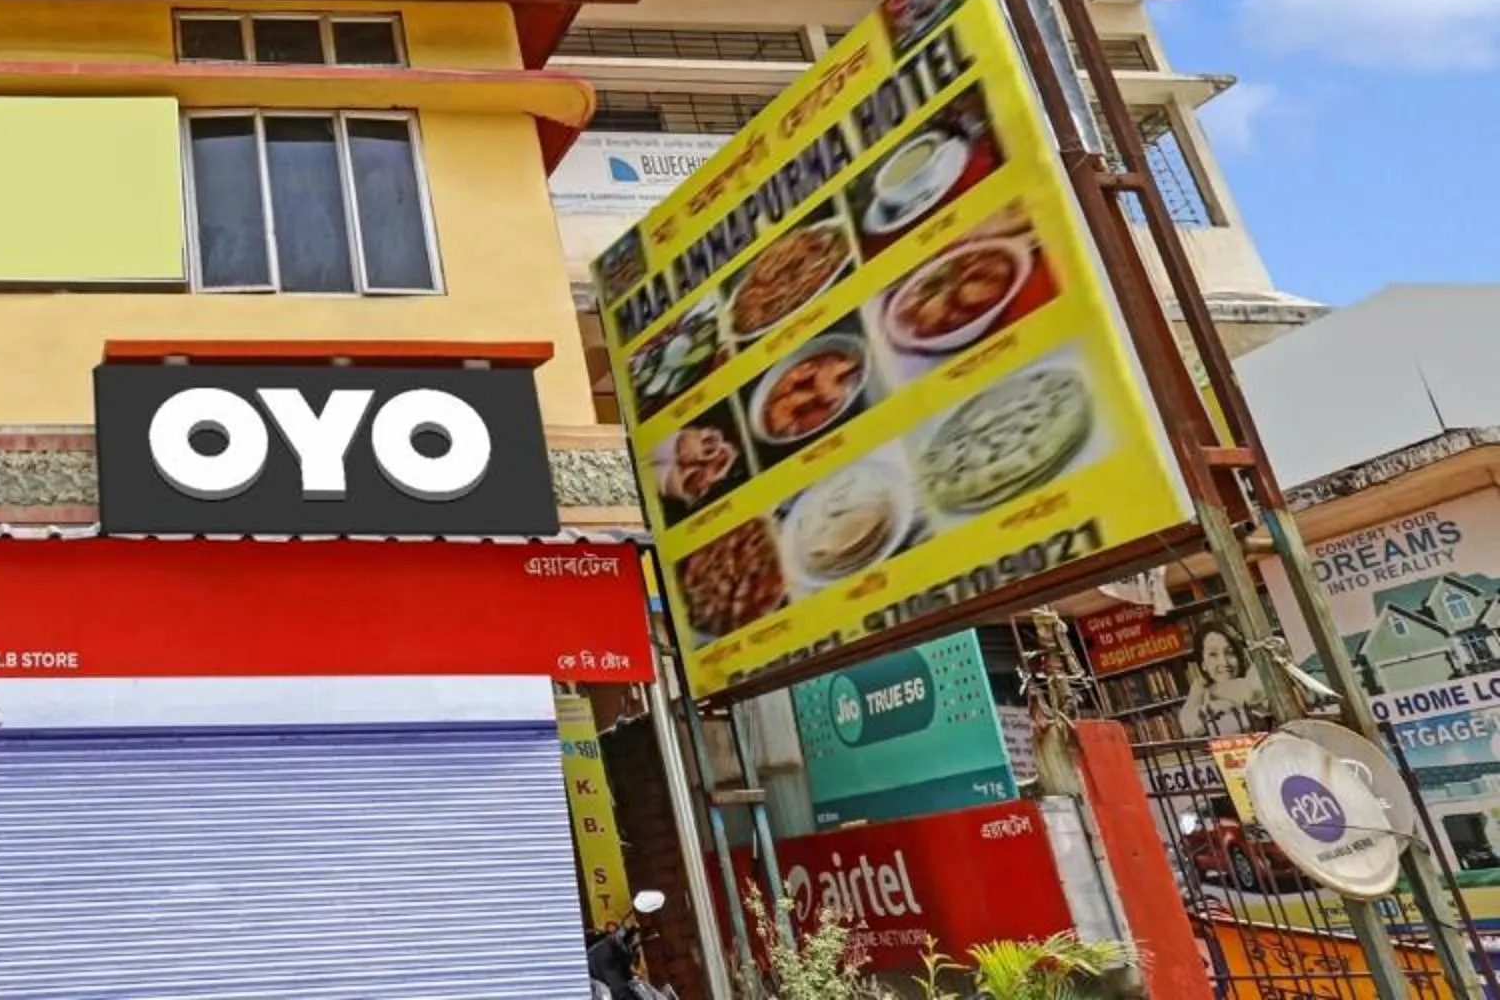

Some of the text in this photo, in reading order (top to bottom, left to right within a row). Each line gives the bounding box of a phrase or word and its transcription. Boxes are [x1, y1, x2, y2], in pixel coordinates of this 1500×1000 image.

[852, 26, 976, 151] HOTEL
[148, 387, 491, 501] OYO
[1312, 521, 1461, 583] DREAMS
[1316, 511, 1439, 558] CONVERT YOUR
[1328, 548, 1456, 596] INTO REALITY
[1087, 611, 1112, 632] Give
[1100, 624, 1142, 645] to your
[21, 651, 79, 668] STORE
[1100, 631, 1180, 667] aspiration
[836, 678, 925, 725] Jio TRUE 5G
[1394, 685, 1470, 717] HOME
[1402, 716, 1488, 749] TGAGE
[1291, 791, 1340, 825] d2h
[819, 850, 922, 919] airtel
